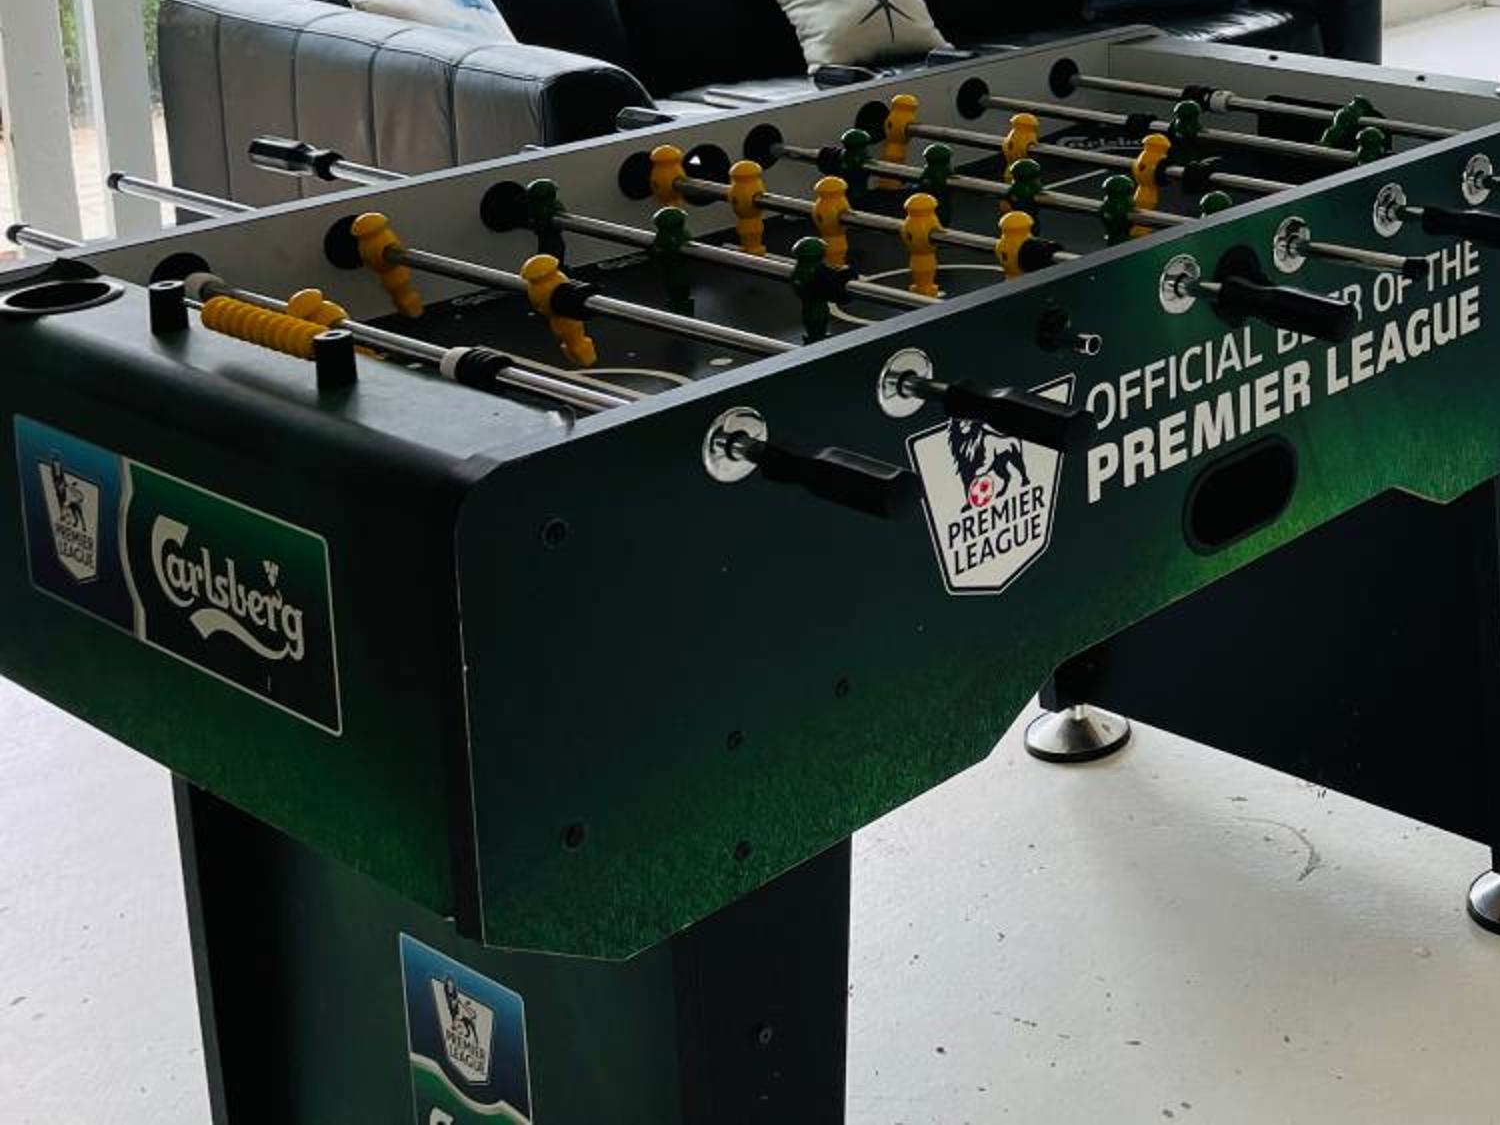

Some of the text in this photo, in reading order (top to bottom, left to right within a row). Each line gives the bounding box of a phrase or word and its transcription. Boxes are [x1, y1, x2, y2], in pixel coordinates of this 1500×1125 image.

[1086, 240, 1481, 430] OFFICIAL BR OF THE
[1086, 286, 1481, 505] PREMIER LEAGUE
[55, 522, 94, 552] PREMIER
[947, 485, 1046, 549] PREMIER
[953, 514, 1043, 576] LEAGUE
[58, 540, 95, 570] LEAGUE
[151, 515, 305, 661] Carlsberg
